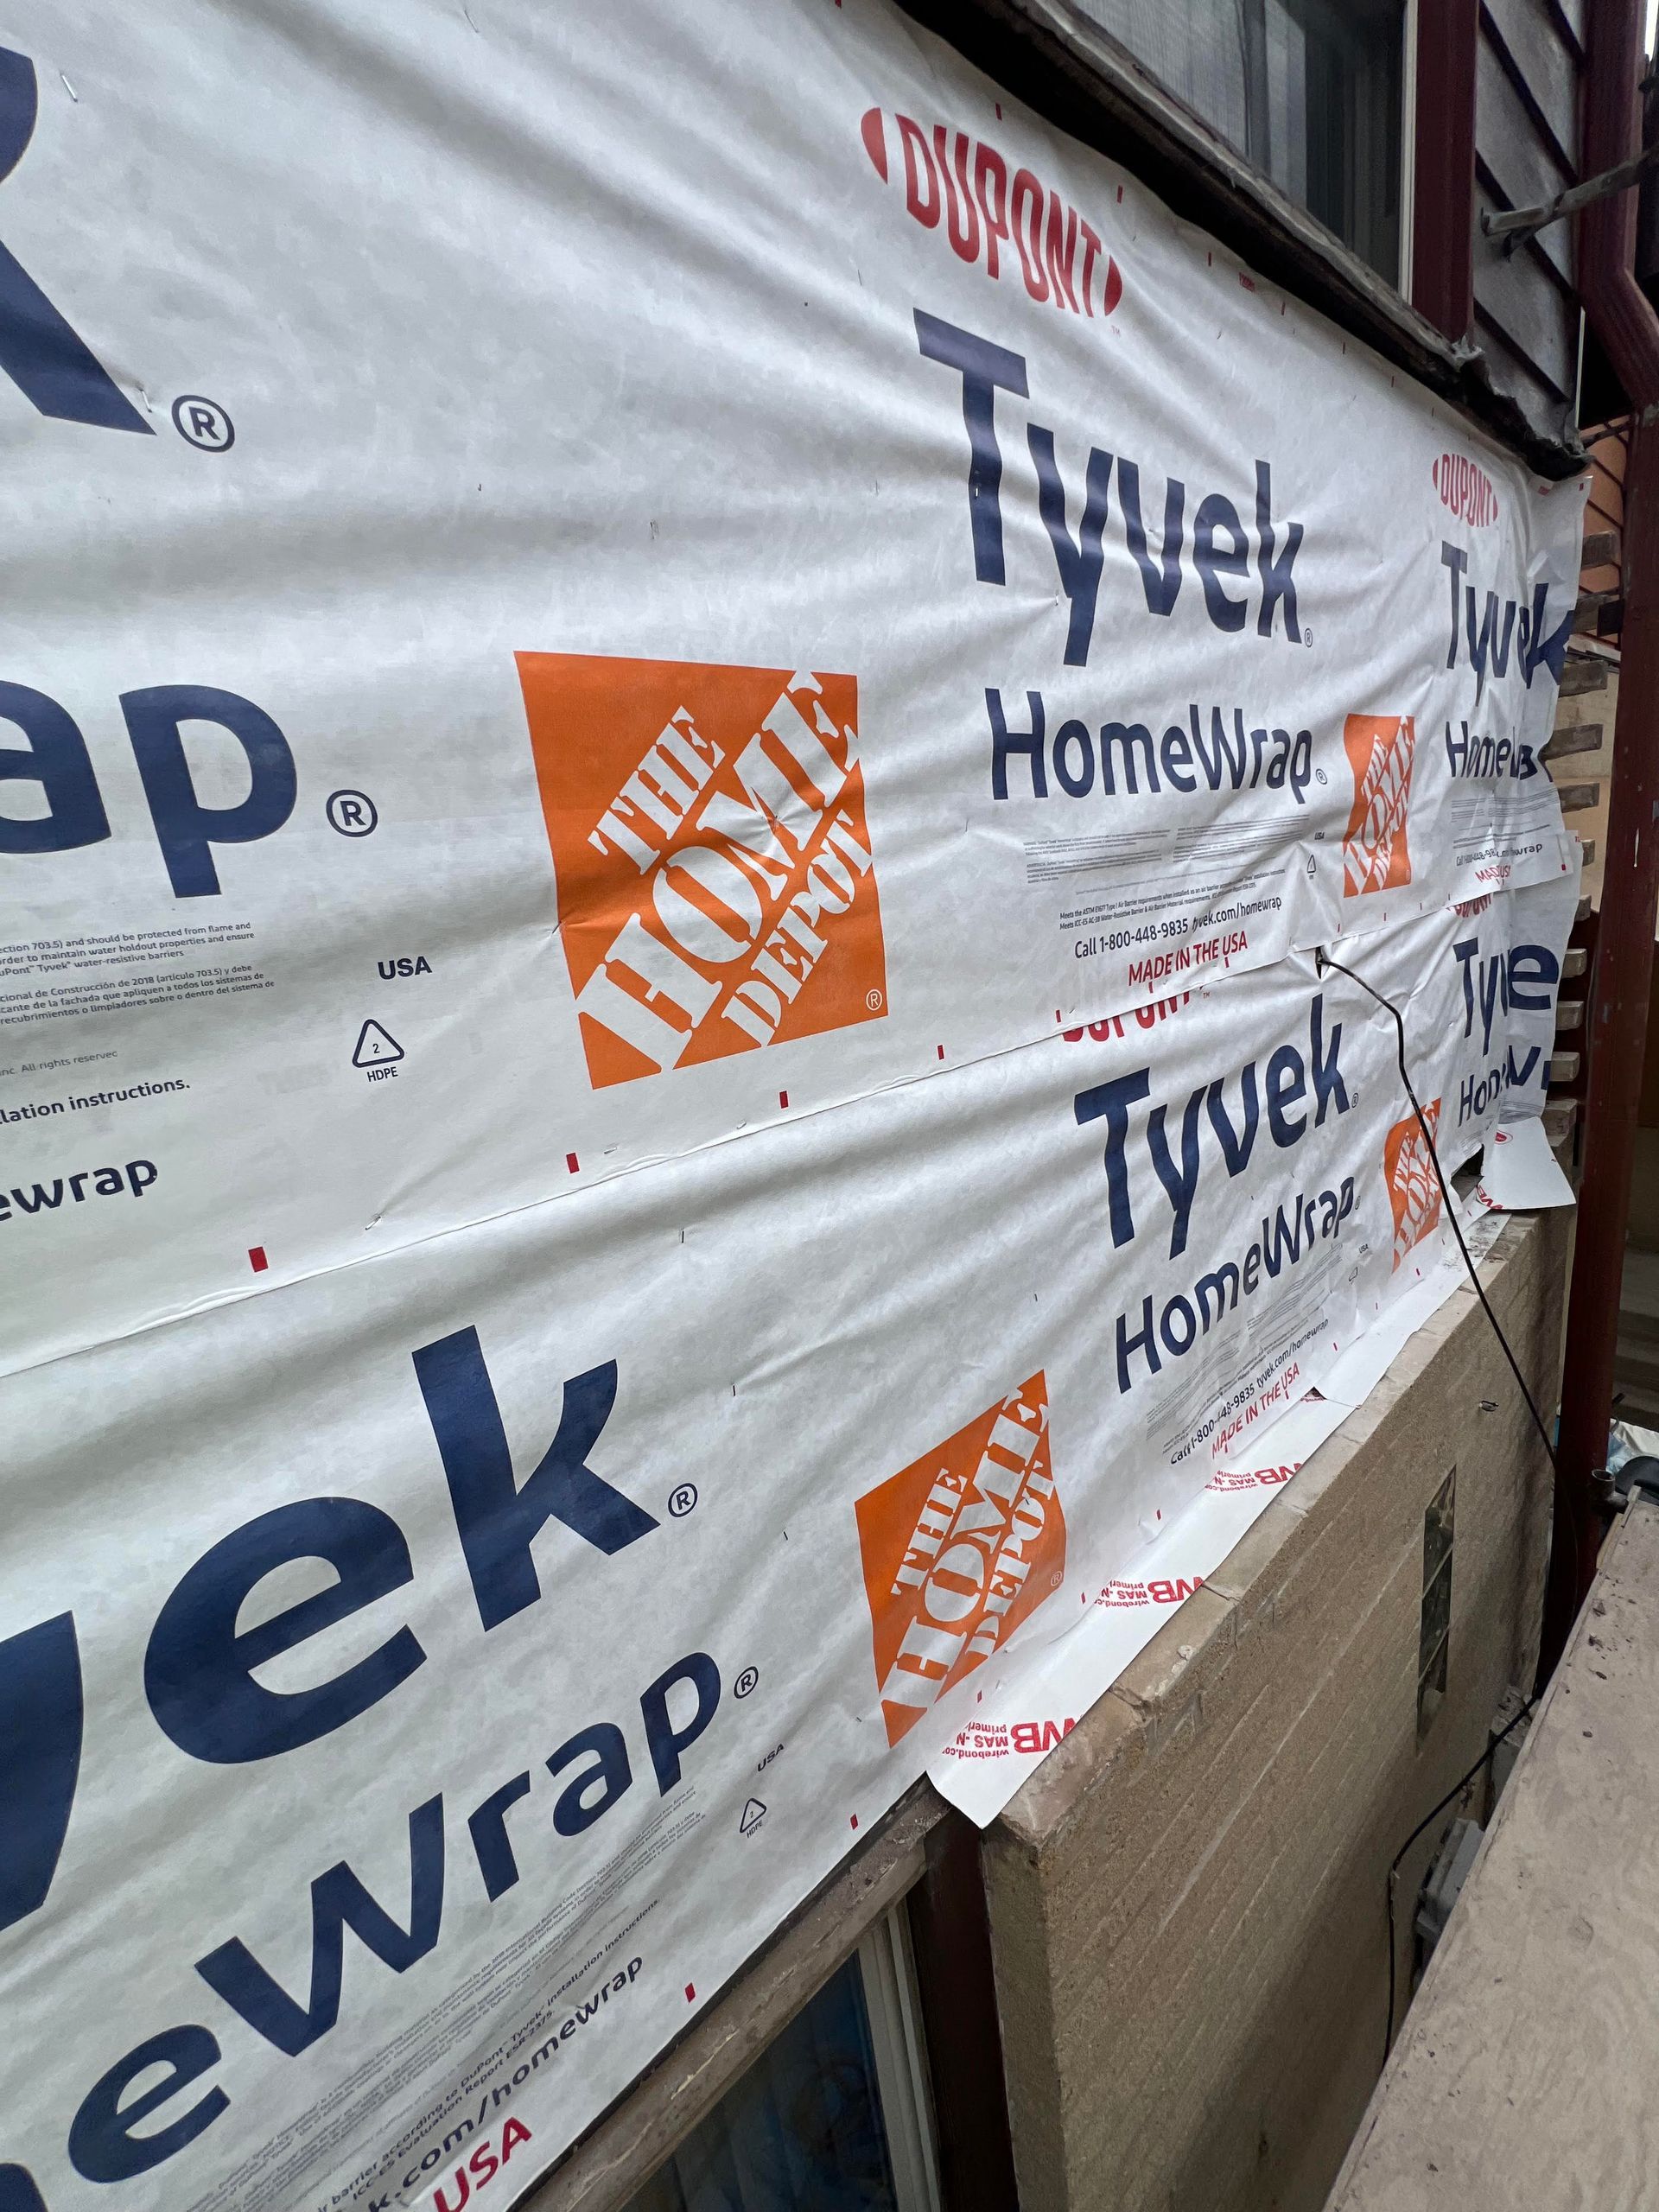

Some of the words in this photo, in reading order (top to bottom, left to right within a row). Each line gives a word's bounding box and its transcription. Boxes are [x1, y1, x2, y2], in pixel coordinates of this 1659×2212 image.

[895, 113, 1102, 318] DUPONT
[1440, 453, 1492, 528] DUPONT
[588, 705, 726, 874] THE
[575, 671, 860, 1071] HOME
[1083, 907, 1095, 916] ASTM
[1106, 904, 1116, 912] Type
[1138, 895, 1162, 906] requirements
[1173, 889, 1190, 899] installed
[41, 950, 86, 961] maintain
[89, 946, 117, 957] water
[119, 942, 157, 954] holdout
[159, 938, 207, 950] properties
[208, 935, 225, 944] and
[226, 932, 255, 942] ensure
[66, 938, 85, 947] and
[87, 934, 120, 945] should
[123, 933, 135, 942] be
[137, 929, 182, 941] protected
[184, 927, 207, 936] from
[208, 925, 233, 933] flame
[721, 809, 873, 1047] DEPOT
[1059, 921, 1074, 930] Meets
[1074, 938, 1097, 959] Call
[1099, 918, 1188, 953] 1-800-448-9835
[1192, 896, 1282, 934] tyvek.com/homewrap
[73, 953, 146, 969] water-resistive
[149, 950, 184, 960] barriers
[378, 955, 433, 981] USA
[1128, 952, 1173, 986] MADE
[1175, 947, 1190, 971] IN
[1193, 938, 1219, 964] THE
[1222, 931, 1248, 956] USA
[50, 982, 115, 996] Construcción
[132, 976, 155, 986] 2018
[232, 964, 252, 973] debe
[60, 994, 100, 1006] fachada
[103, 992, 121, 1001] que
[124, 986, 164, 999] apliquen
[174, 982, 199, 990] todos
[216, 975, 252, 985] sistemas
[0, 1007, 79, 1025] recubrimientos
[91, 999, 147, 1013] limpiadores
[149, 995, 175, 1004] sobre
[185, 989, 214, 999] dentro
[216, 985, 230, 995] del
[232, 983, 264, 993] sistema
[22, 1064, 36, 1073] All
[39, 1058, 71, 1071] rights
[366, 1065, 398, 1083] HDPE
[0, 1103, 65, 1125] lation
[68, 1079, 190, 1110] instructions.
[1256, 1319, 1329, 1389] tyvek.com/homewrap
[1211, 1414, 1243, 1460] MADE
[1245, 1401, 1259, 1424] IN
[1260, 1382, 1281, 1410] THE
[1281, 1362, 1300, 1392] USA
[1228, 1477, 1255, 1486] MAS
[880, 1386, 1050, 1713] HOME
[891, 1468, 968, 1595] THE
[965, 1460, 1053, 1657] DEPOT
[1116, 1590, 1148, 1599] MAS
[756, 1742, 785, 1772] USA
[942, 1746, 1010, 1759] wirebond.co
[974, 1734, 1009, 1749] MAS
[746, 1818, 765, 1839] HDPE
[331, 2161, 378, 2206] barrier
[382, 2101, 443, 2163] according
[446, 2088, 458, 2103] to
[547, 1950, 603, 2007] installation
[605, 1898, 661, 1954] instructions.
[397, 2096, 463, 2159] Evaluation
[465, 2058, 505, 2095] Report
[433, 2116, 533, 2212] USA
